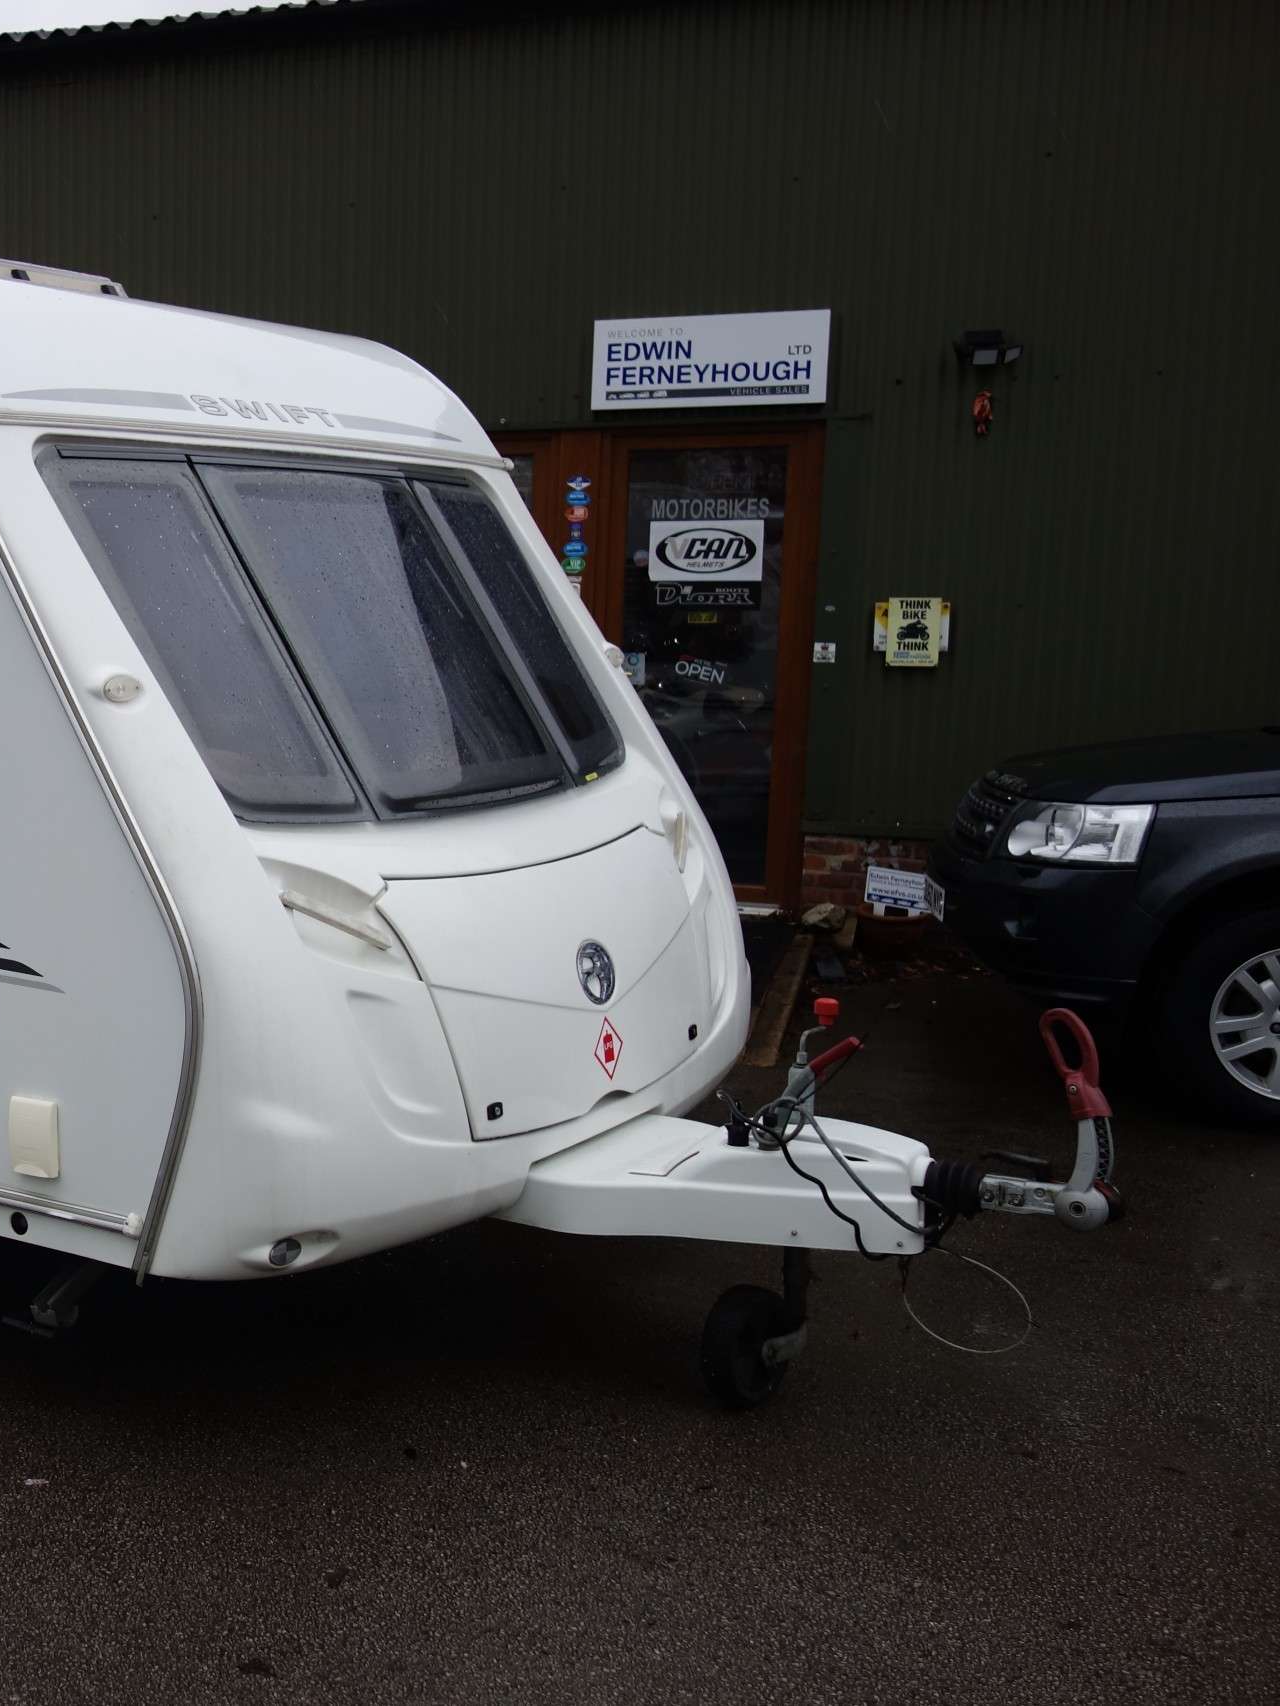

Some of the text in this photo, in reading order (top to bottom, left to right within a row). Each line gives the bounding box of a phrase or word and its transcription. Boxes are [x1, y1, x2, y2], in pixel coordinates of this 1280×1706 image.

[607, 327, 684, 338] WELCOME TO
[607, 340, 692, 362] EDWIN
[787, 344, 813, 355] LTD
[606, 360, 812, 386] FERNEYHOUGH
[729, 385, 808, 396] VEHICLE SALES
[190, 394, 335, 428] SWIFT
[651, 497, 770, 519] MOTORBIKES
[899, 600, 932, 610] THINK
[902, 610, 928, 620] BIKE
[896, 641, 929, 652] THINK
[675, 660, 726, 684] OPEN
